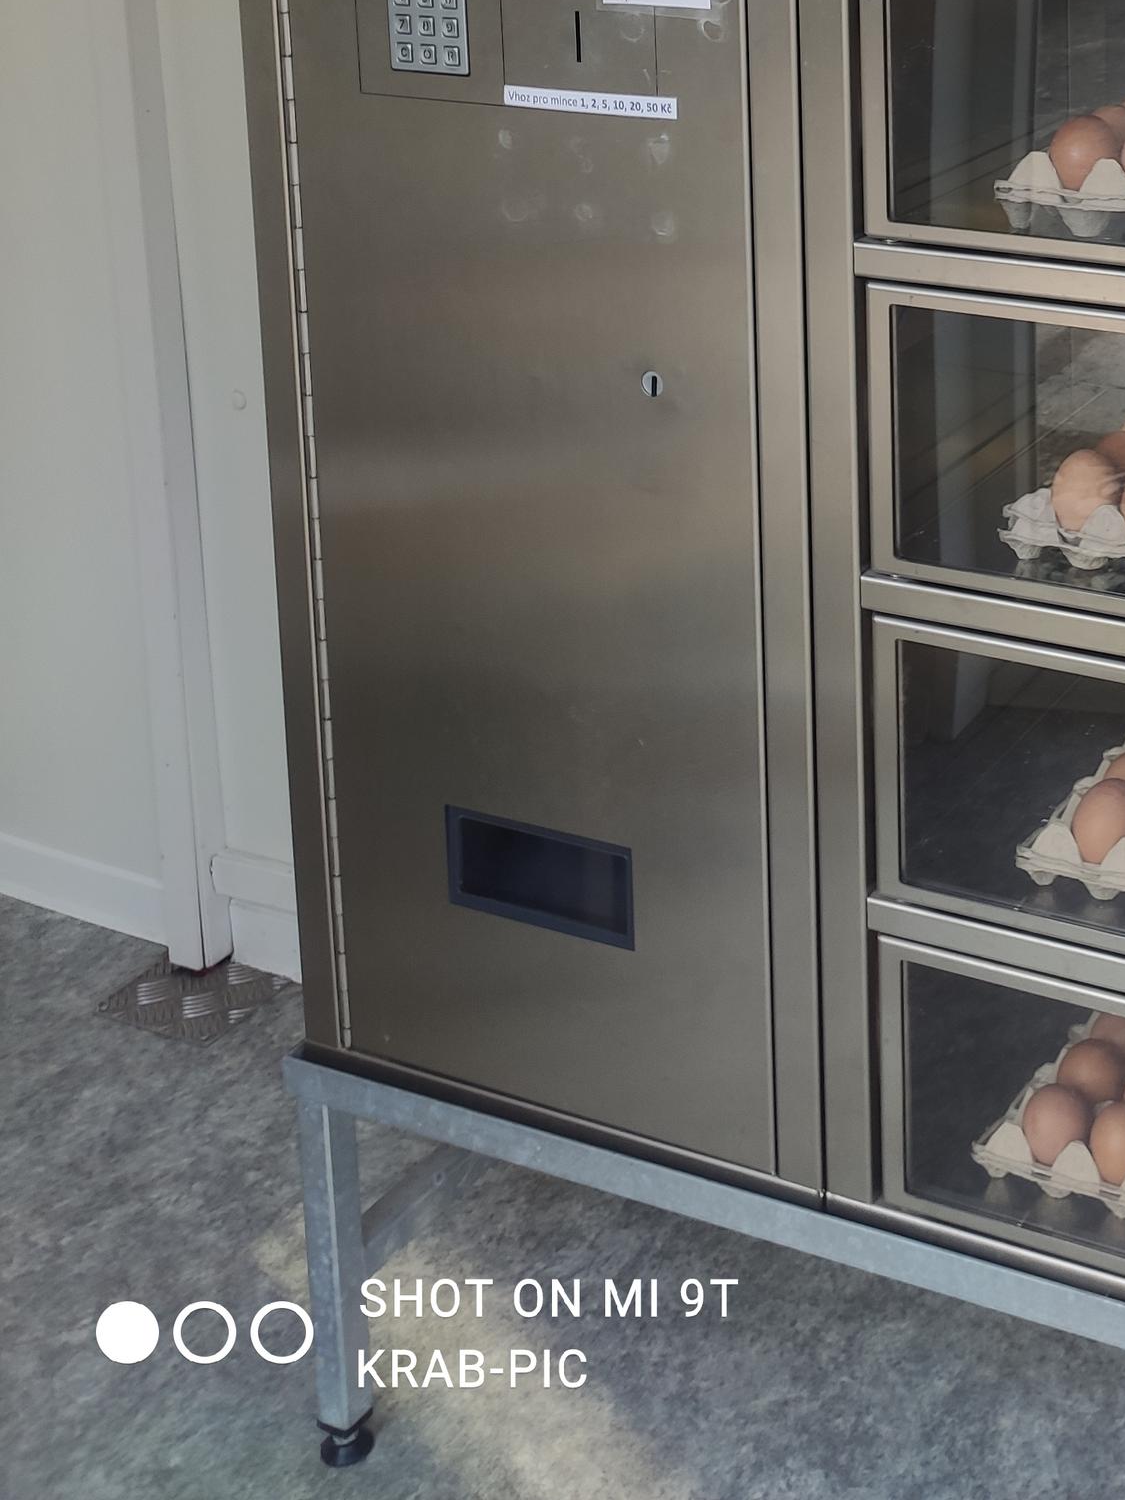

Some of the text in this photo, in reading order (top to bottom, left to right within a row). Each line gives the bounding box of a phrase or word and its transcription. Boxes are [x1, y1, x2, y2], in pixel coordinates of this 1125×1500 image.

[508, 90, 672, 114] Vhoz pro mince 1, 2, 5, 10, 20, 50 Kč
